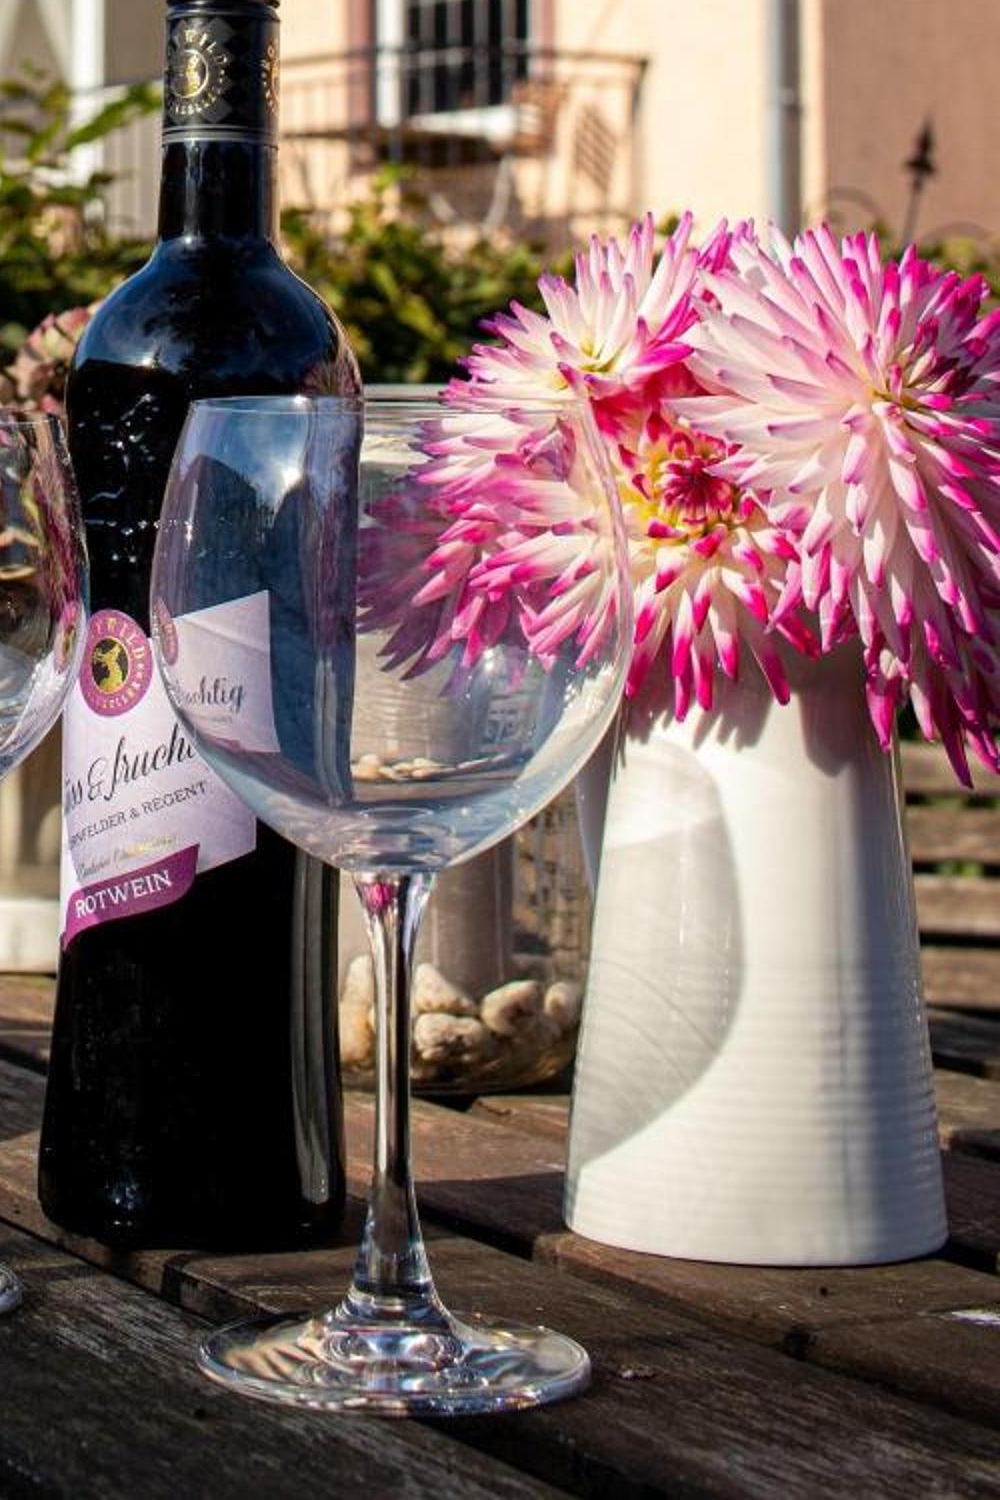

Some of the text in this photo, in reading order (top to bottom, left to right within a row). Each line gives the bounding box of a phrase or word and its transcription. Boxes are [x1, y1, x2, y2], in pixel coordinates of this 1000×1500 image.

[87, 756, 107, 801] &
[129, 807, 140, 820] &
[141, 780, 207, 814] REGENT
[75, 869, 173, 918] ROTWEIN
